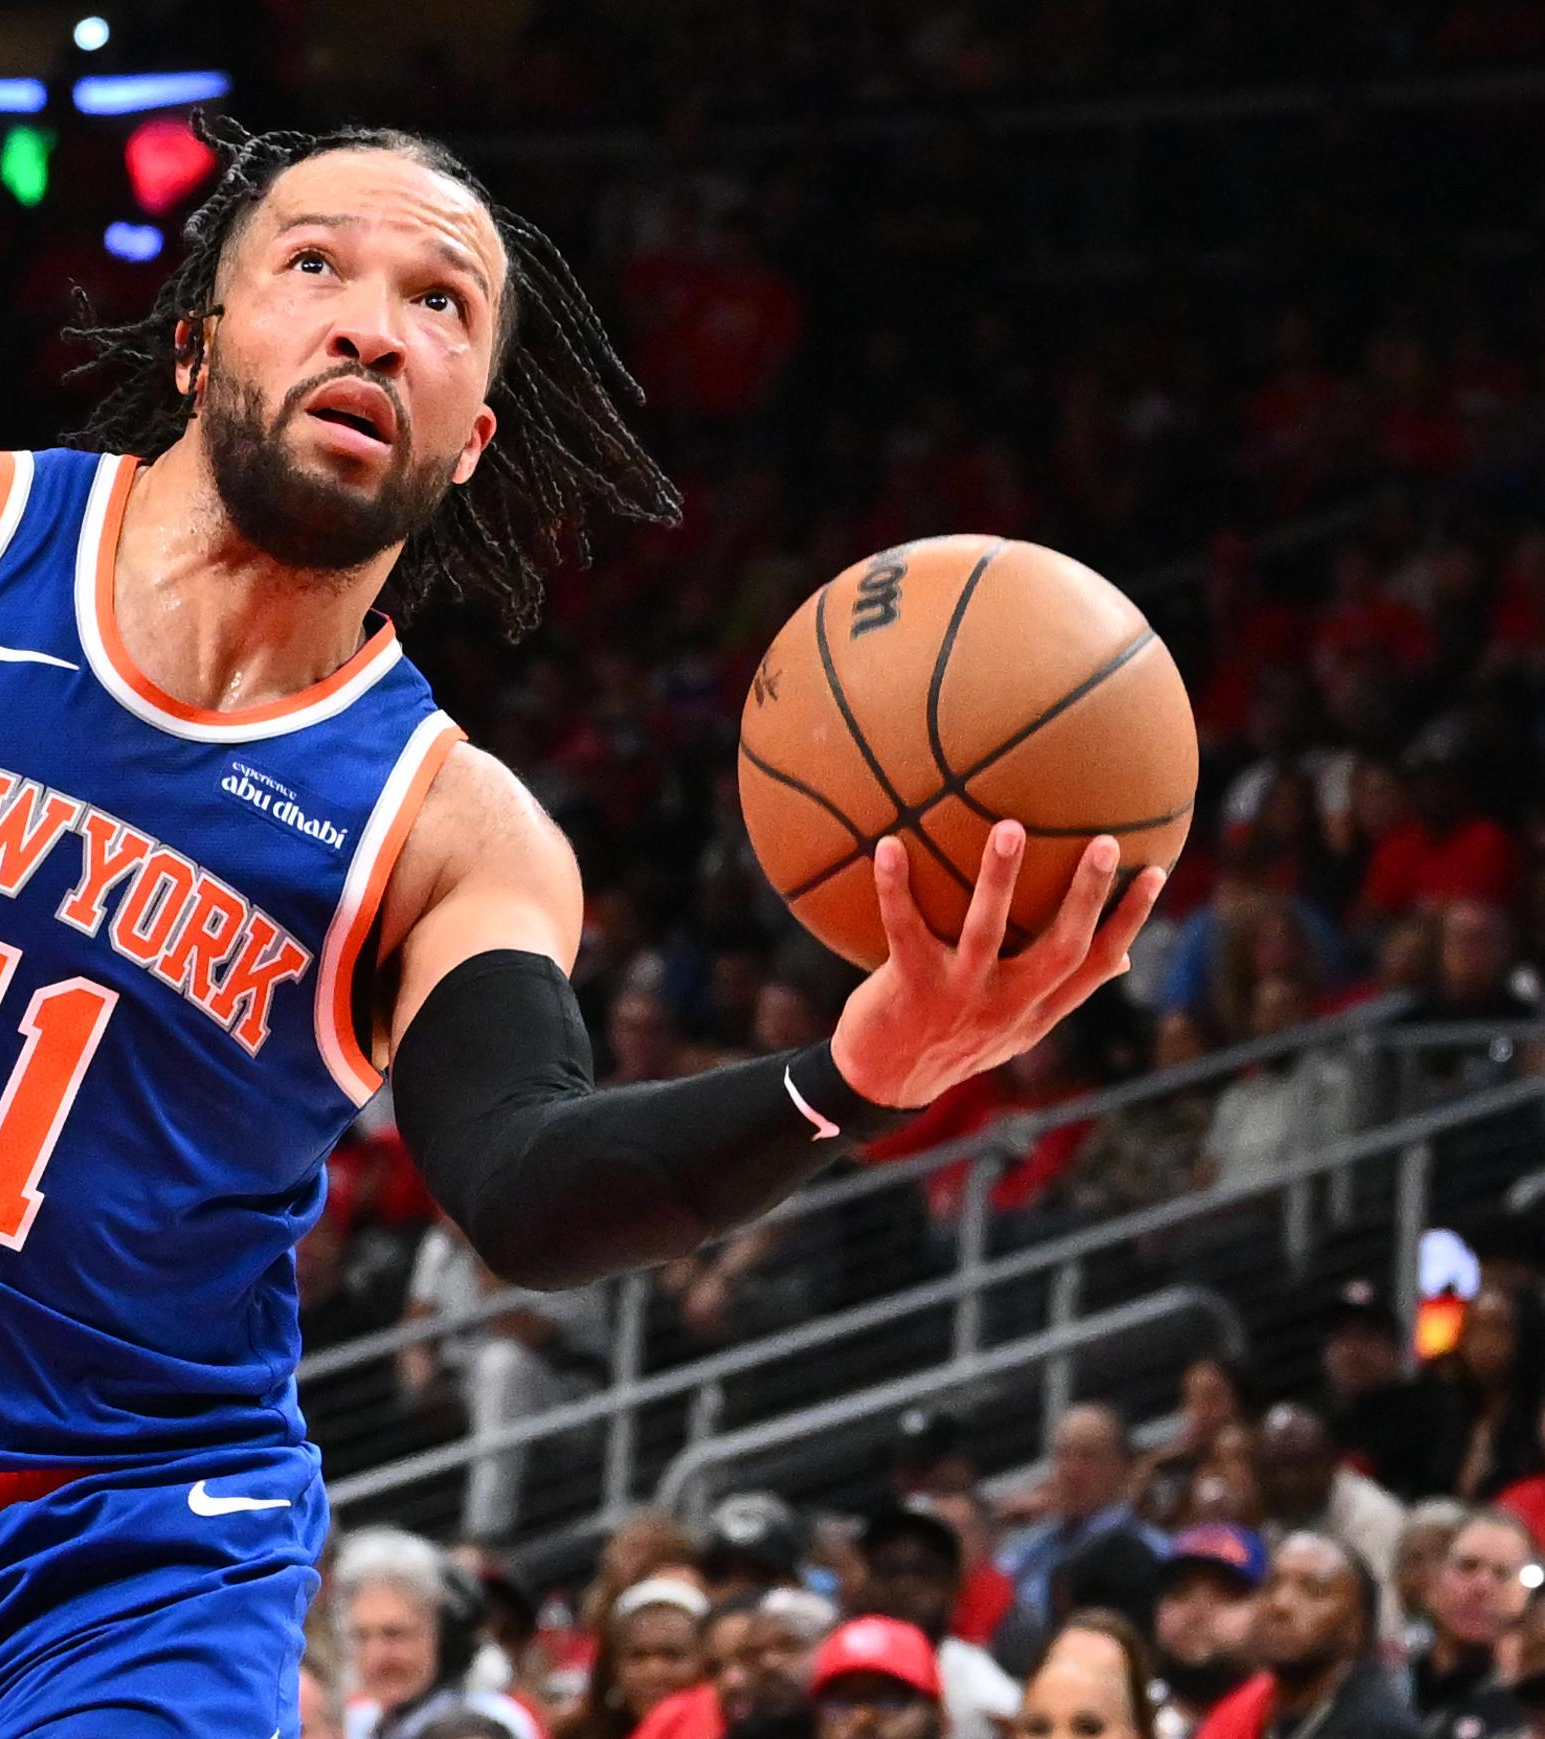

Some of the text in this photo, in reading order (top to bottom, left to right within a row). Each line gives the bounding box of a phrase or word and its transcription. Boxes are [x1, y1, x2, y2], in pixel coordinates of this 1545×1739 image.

[221, 775, 349, 850] abu dhabi
[232, 761, 298, 800] experience
[54, 803, 315, 1058] YORK
